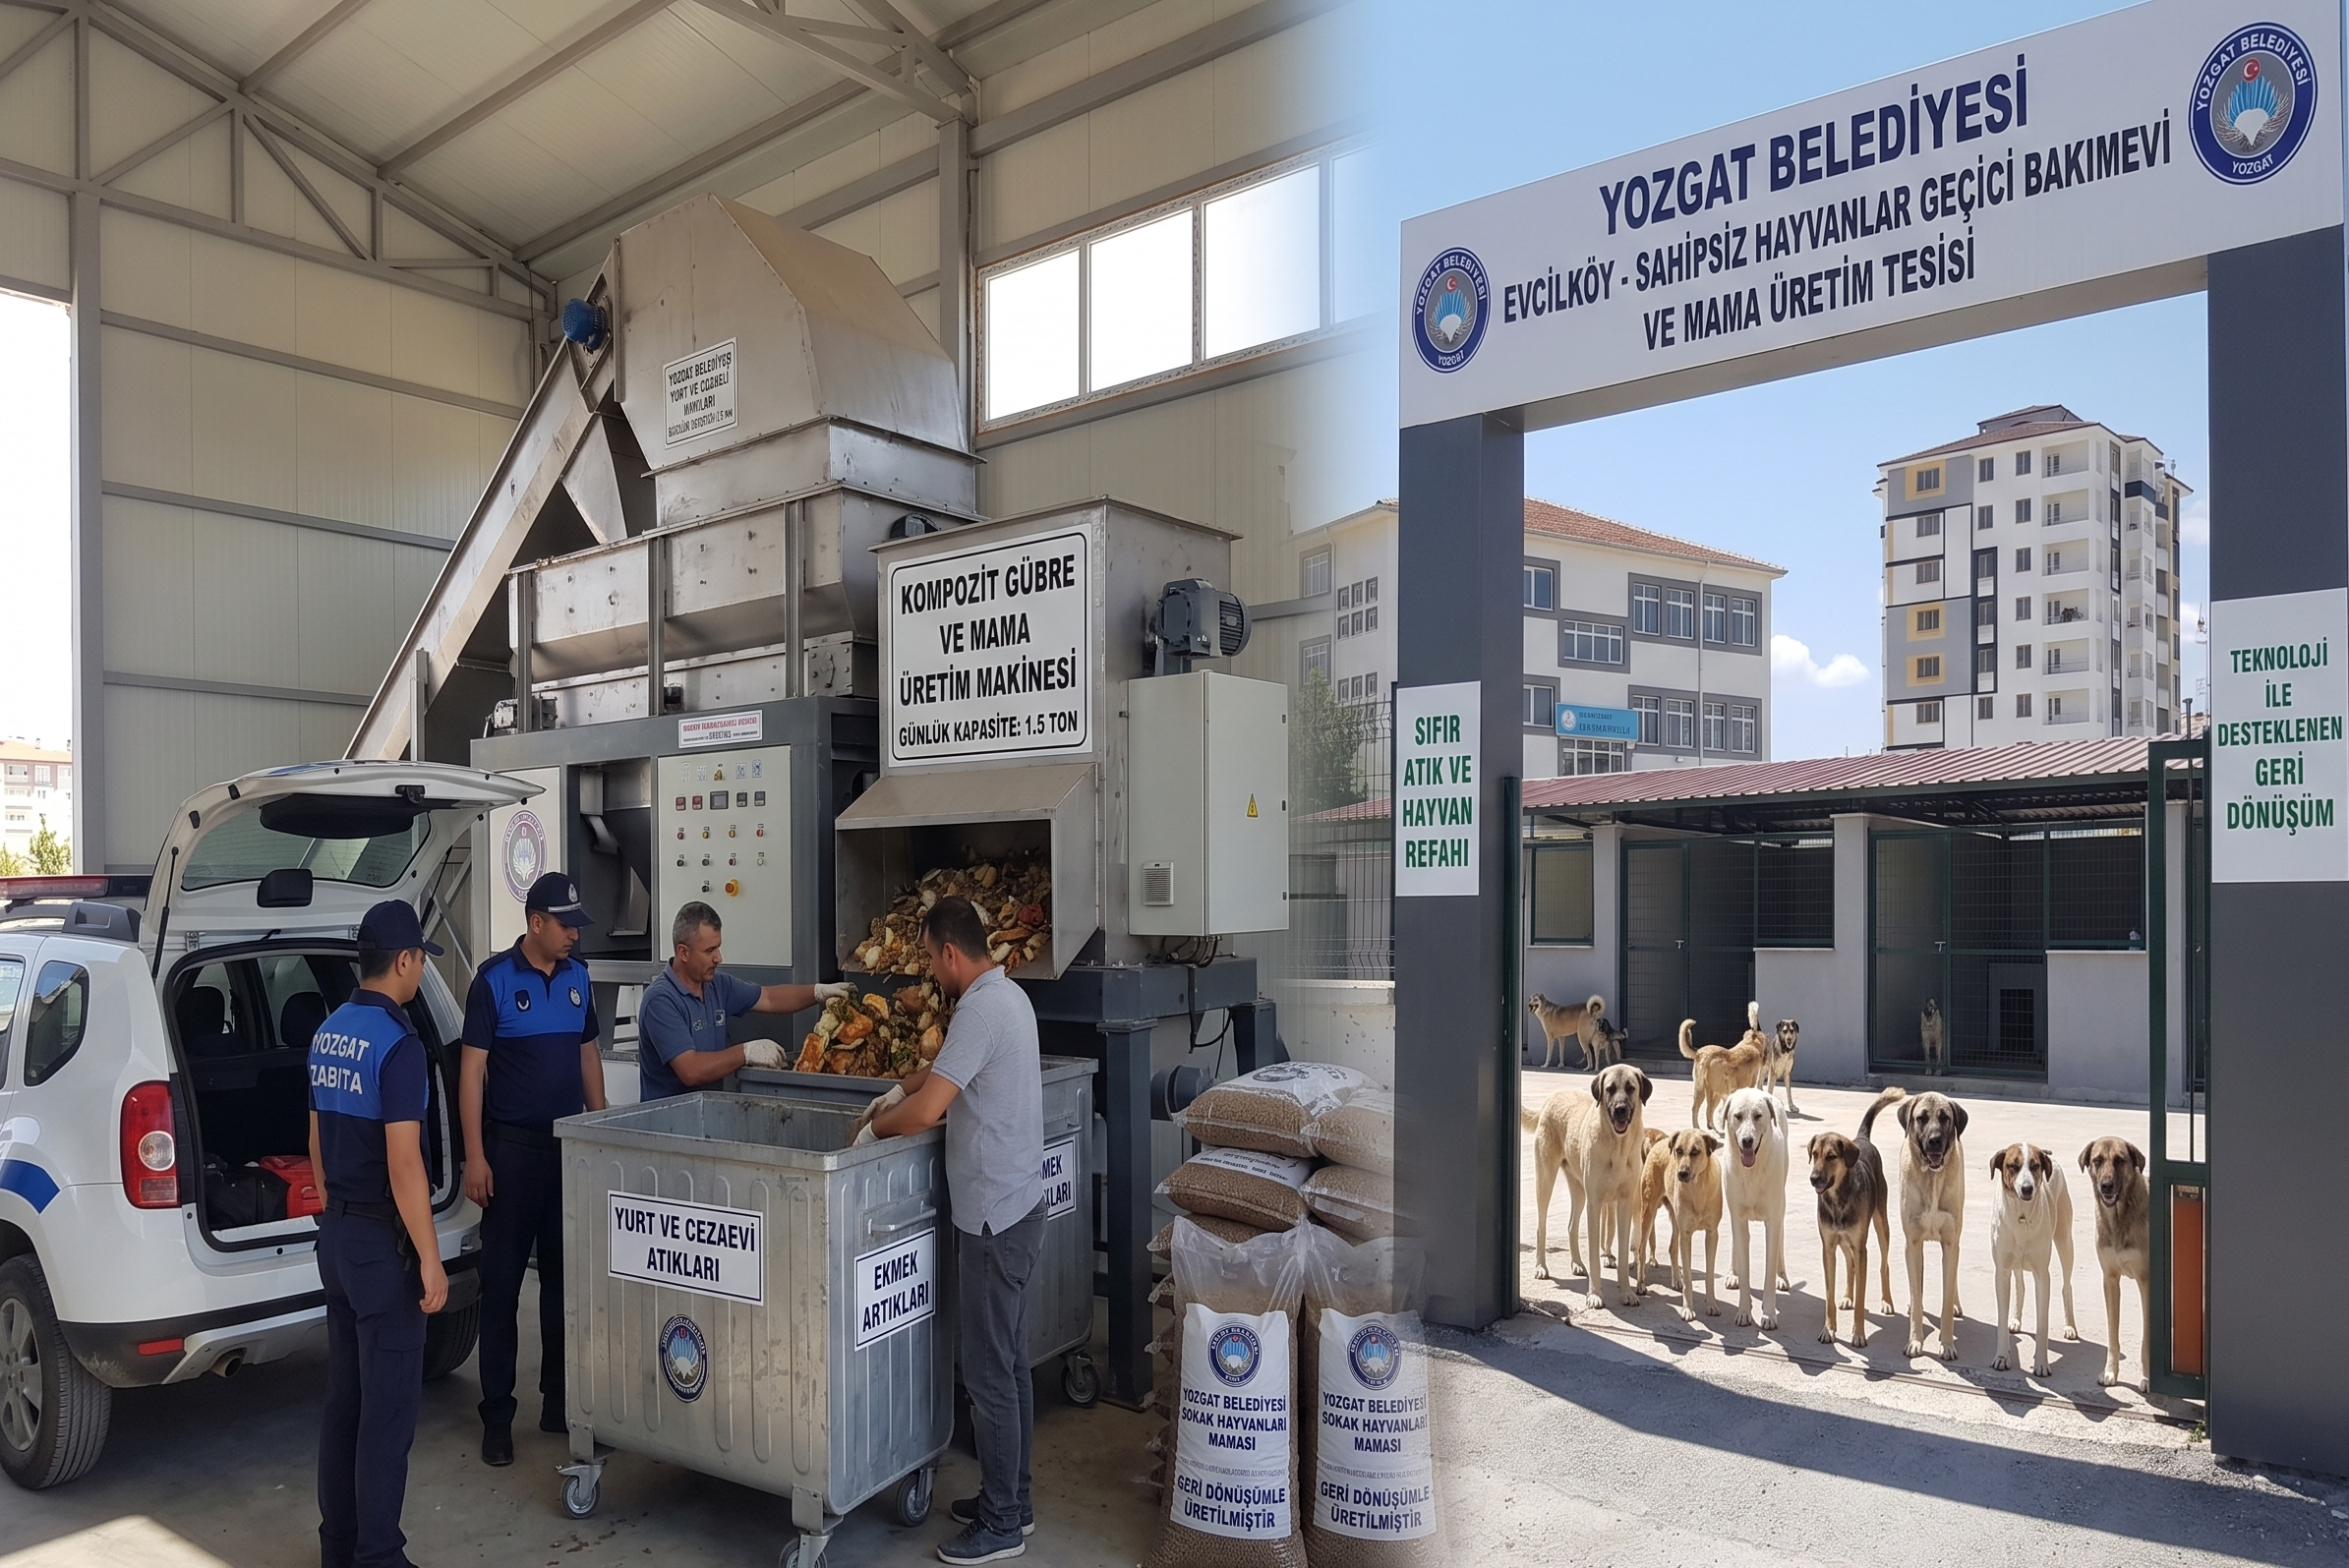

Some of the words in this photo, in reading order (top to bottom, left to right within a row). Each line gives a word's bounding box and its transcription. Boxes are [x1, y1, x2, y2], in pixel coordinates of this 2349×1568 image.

[2196, 43, 2236, 111] YOZGAT
[1599, 143, 1756, 235] YOZGAT
[1770, 53, 2027, 193] BELEDİYESİ
[2232, 154, 2274, 174] YOZGAT
[1503, 256, 1615, 323] EVCİLKÖY
[1635, 221, 1747, 292] SAHİPSİZ
[1755, 185, 1911, 263] HAYVANLAR
[1919, 147, 2014, 223] GEÇİCİ
[2025, 108, 2170, 198] BAKIMEVİ
[1643, 307, 1674, 351] VE
[1684, 288, 1761, 343] MAMA
[1770, 255, 1873, 322] ÜRETİM
[1882, 226, 1974, 297] TESİSİ
[689, 382, 699, 396] VE
[901, 563, 999, 615] KOMPOZİT
[1005, 553, 1075, 598] GÜBRE
[939, 621, 965, 656] VE
[970, 611, 1030, 651] MAMA
[2230, 636, 2327, 673] TEKNOLOJİ
[900, 664, 970, 706] ÜRETİM
[976, 647, 1076, 699] MAKİNESİ
[2265, 678, 2292, 708] İLE
[899, 719, 950, 747] GÜNLÜK
[954, 712, 1021, 742] KAPASİTE:
[1025, 713, 1045, 736] 1.5
[1048, 710, 1078, 734] TON
[1415, 715, 1460, 745] SIFIR
[2217, 716, 2342, 747] DESTEKLENEN
[1403, 756, 1443, 786] ATIK
[1448, 755, 1472, 784] VE
[2256, 750, 2304, 786] GERİ
[1402, 796, 1472, 827] HAYVAN
[2227, 792, 2334, 836] DÖNÜŞÜM
[1405, 839, 1469, 868] REFAHI
[312, 1032, 370, 1062] YOZGAT
[310, 1064, 363, 1095] ZABITA
[1041, 1154, 1063, 1180] MEK
[615, 1206, 655, 1235] YURT
[659, 1213, 680, 1240] VE
[684, 1222, 755, 1252] CEZAEVİ
[646, 1247, 720, 1282] ATIKLARI
[874, 1249, 918, 1291] EKMEK
[862, 1280, 929, 1332] ARTIKLARI
[1183, 1387, 1220, 1408] YOZGAT
[1223, 1395, 1286, 1413] BELEDİYESİ
[1322, 1391, 1365, 1413] YOZGAT
[1369, 1393, 1427, 1414] BELEDİYESİ
[1181, 1407, 1214, 1427] SOKAK
[1217, 1416, 1287, 1431] HAYVANLARI
[1321, 1411, 1359, 1431] SOKAK
[1362, 1414, 1428, 1433] HAYVANLARI
[1208, 1431, 1256, 1451] MAMASI
[1354, 1436, 1401, 1453] MAMASI
[1177, 1475, 1203, 1496] GERİ
[1205, 1483, 1286, 1508] DÖNÜŞÜMLE
[1321, 1481, 1349, 1503] GERİ
[1353, 1485, 1430, 1510] DÖNÜŞÜMLE
[1184, 1499, 1275, 1532] ÜRETİLMİŞTİR
[1330, 1503, 1423, 1533] ÜRETİLMİŞTİR
